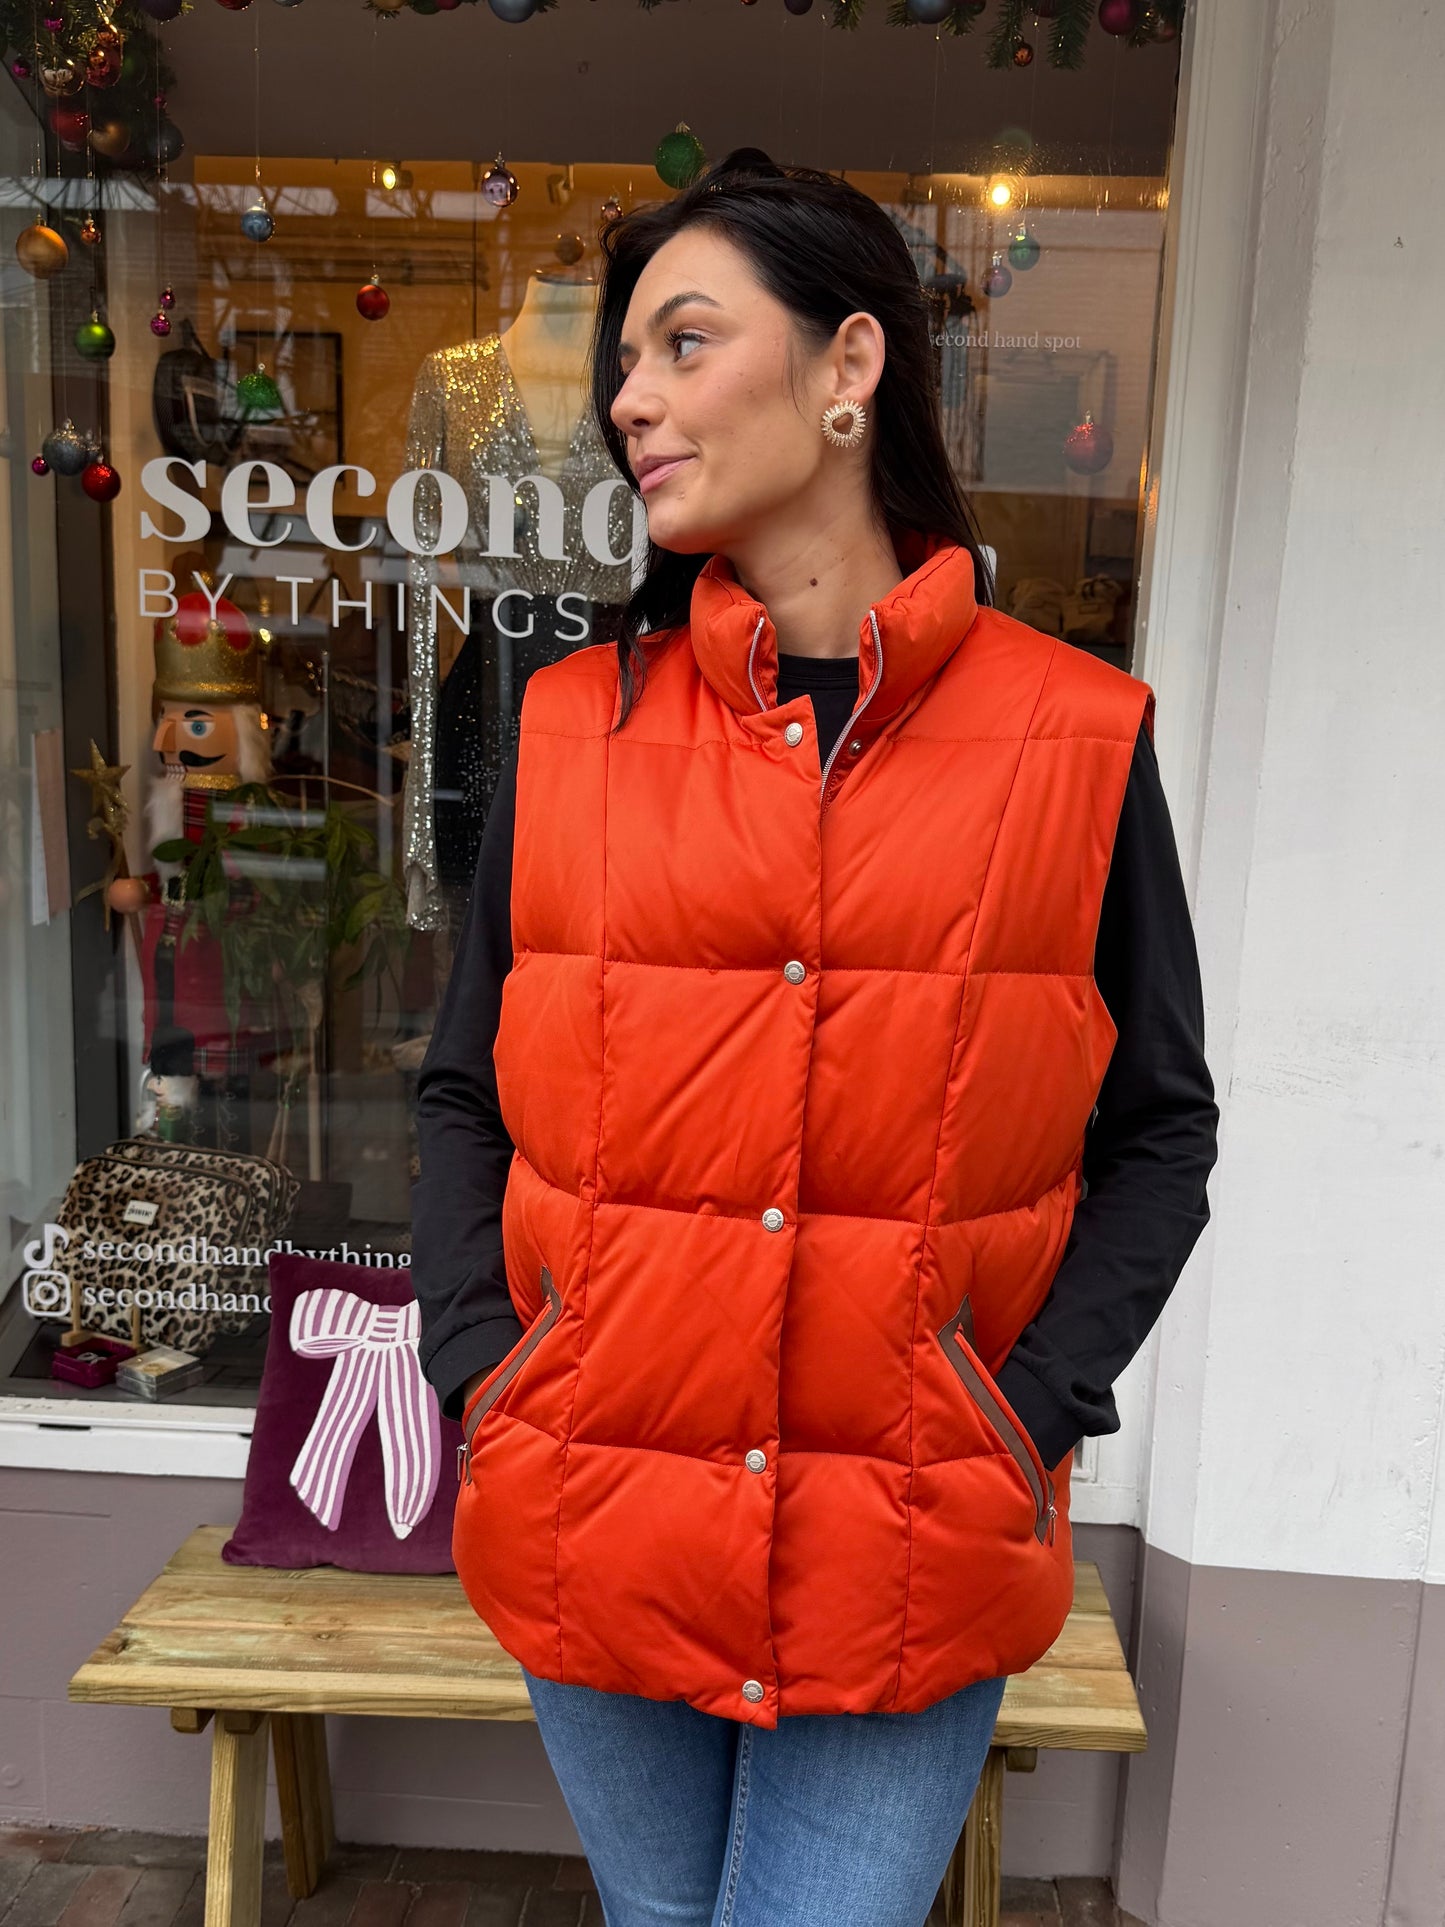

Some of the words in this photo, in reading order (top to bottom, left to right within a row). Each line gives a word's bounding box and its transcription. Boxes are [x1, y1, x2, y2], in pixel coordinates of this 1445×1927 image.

[994, 331, 1039, 347] hand
[1044, 335, 1080, 352] spot
[138, 568, 232, 619] BY
[276, 576, 590, 641] THINGS
